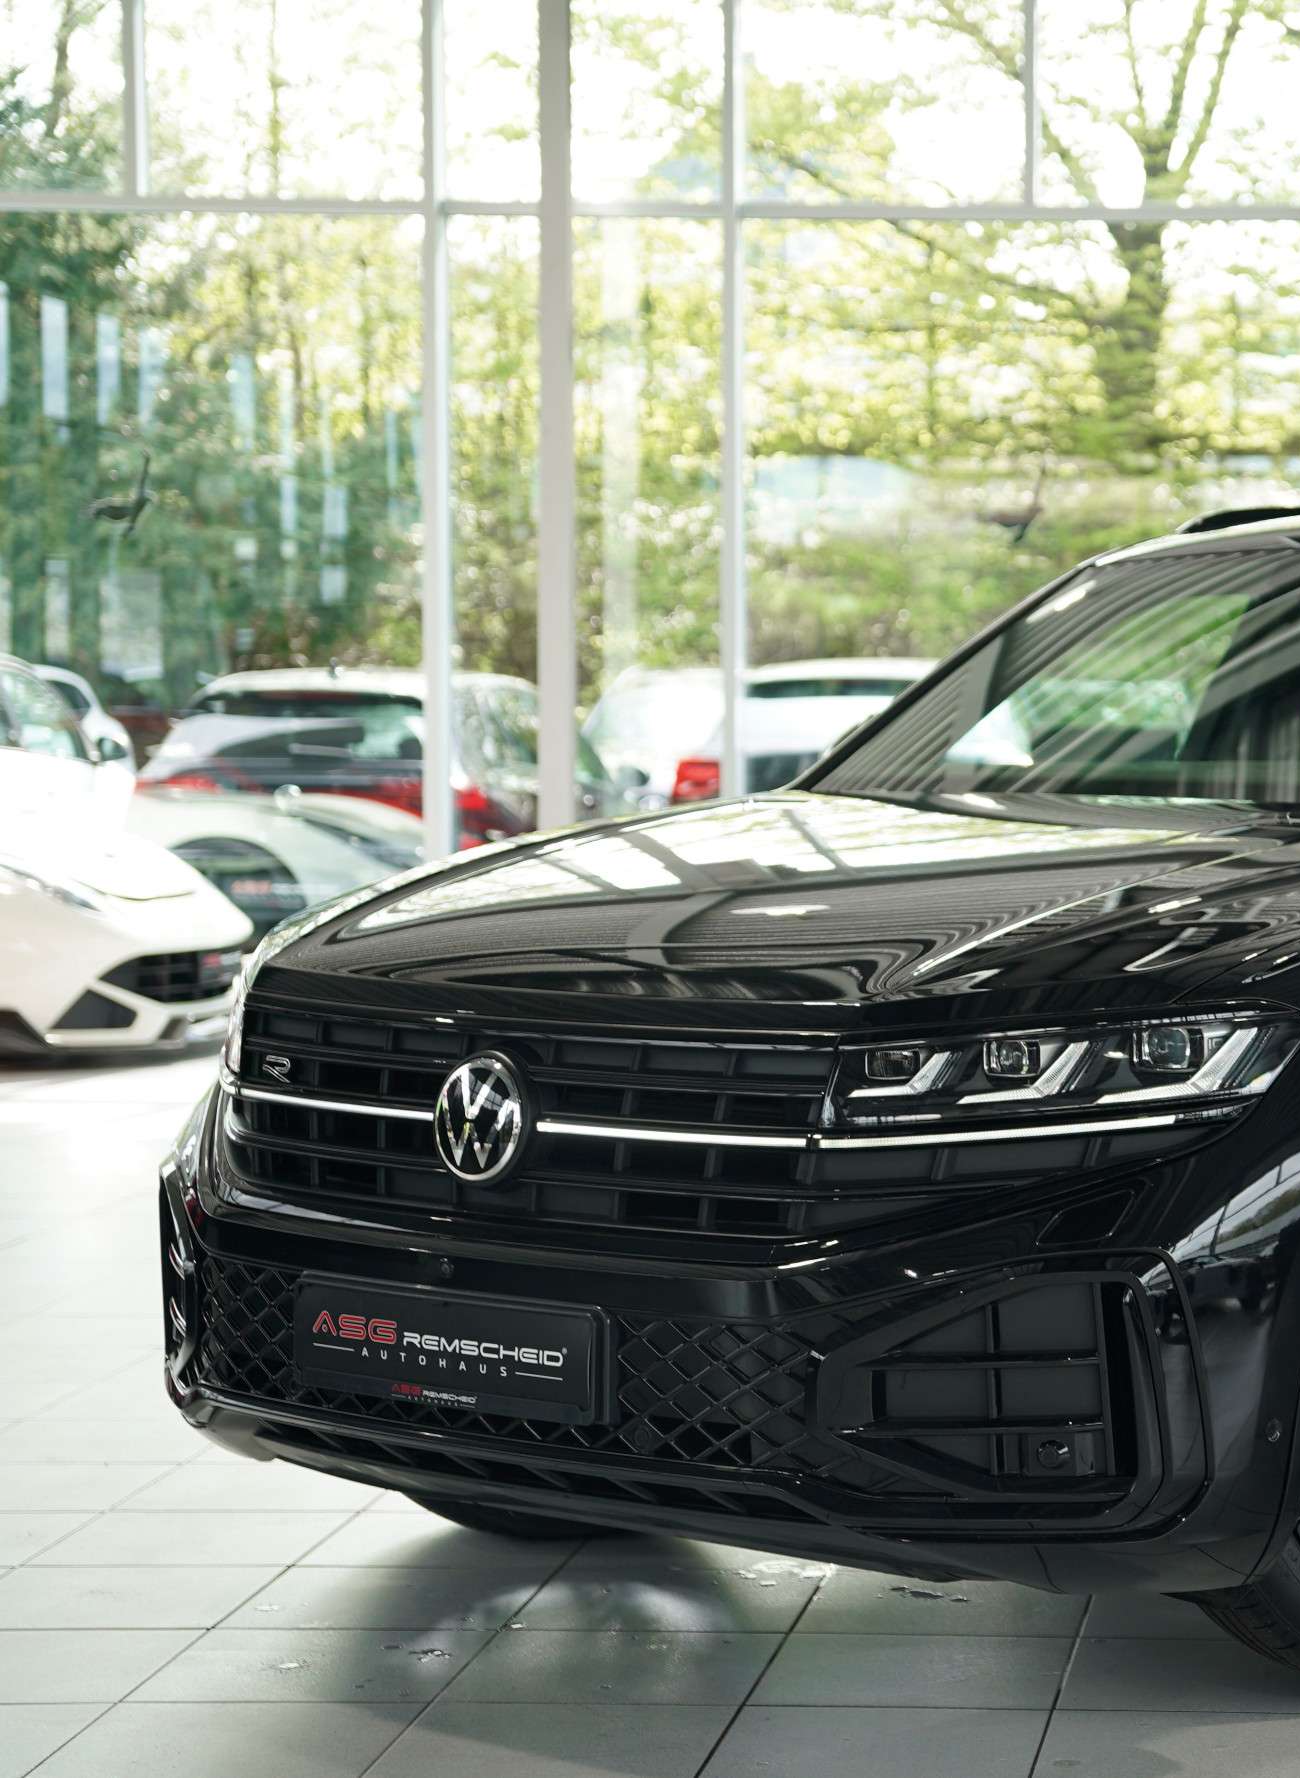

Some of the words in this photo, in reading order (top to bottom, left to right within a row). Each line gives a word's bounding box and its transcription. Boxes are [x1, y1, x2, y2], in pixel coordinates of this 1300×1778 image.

[262, 1055, 291, 1084] R
[312, 1310, 397, 1345] ASG
[361, 1346, 508, 1377] AUTOHAUS
